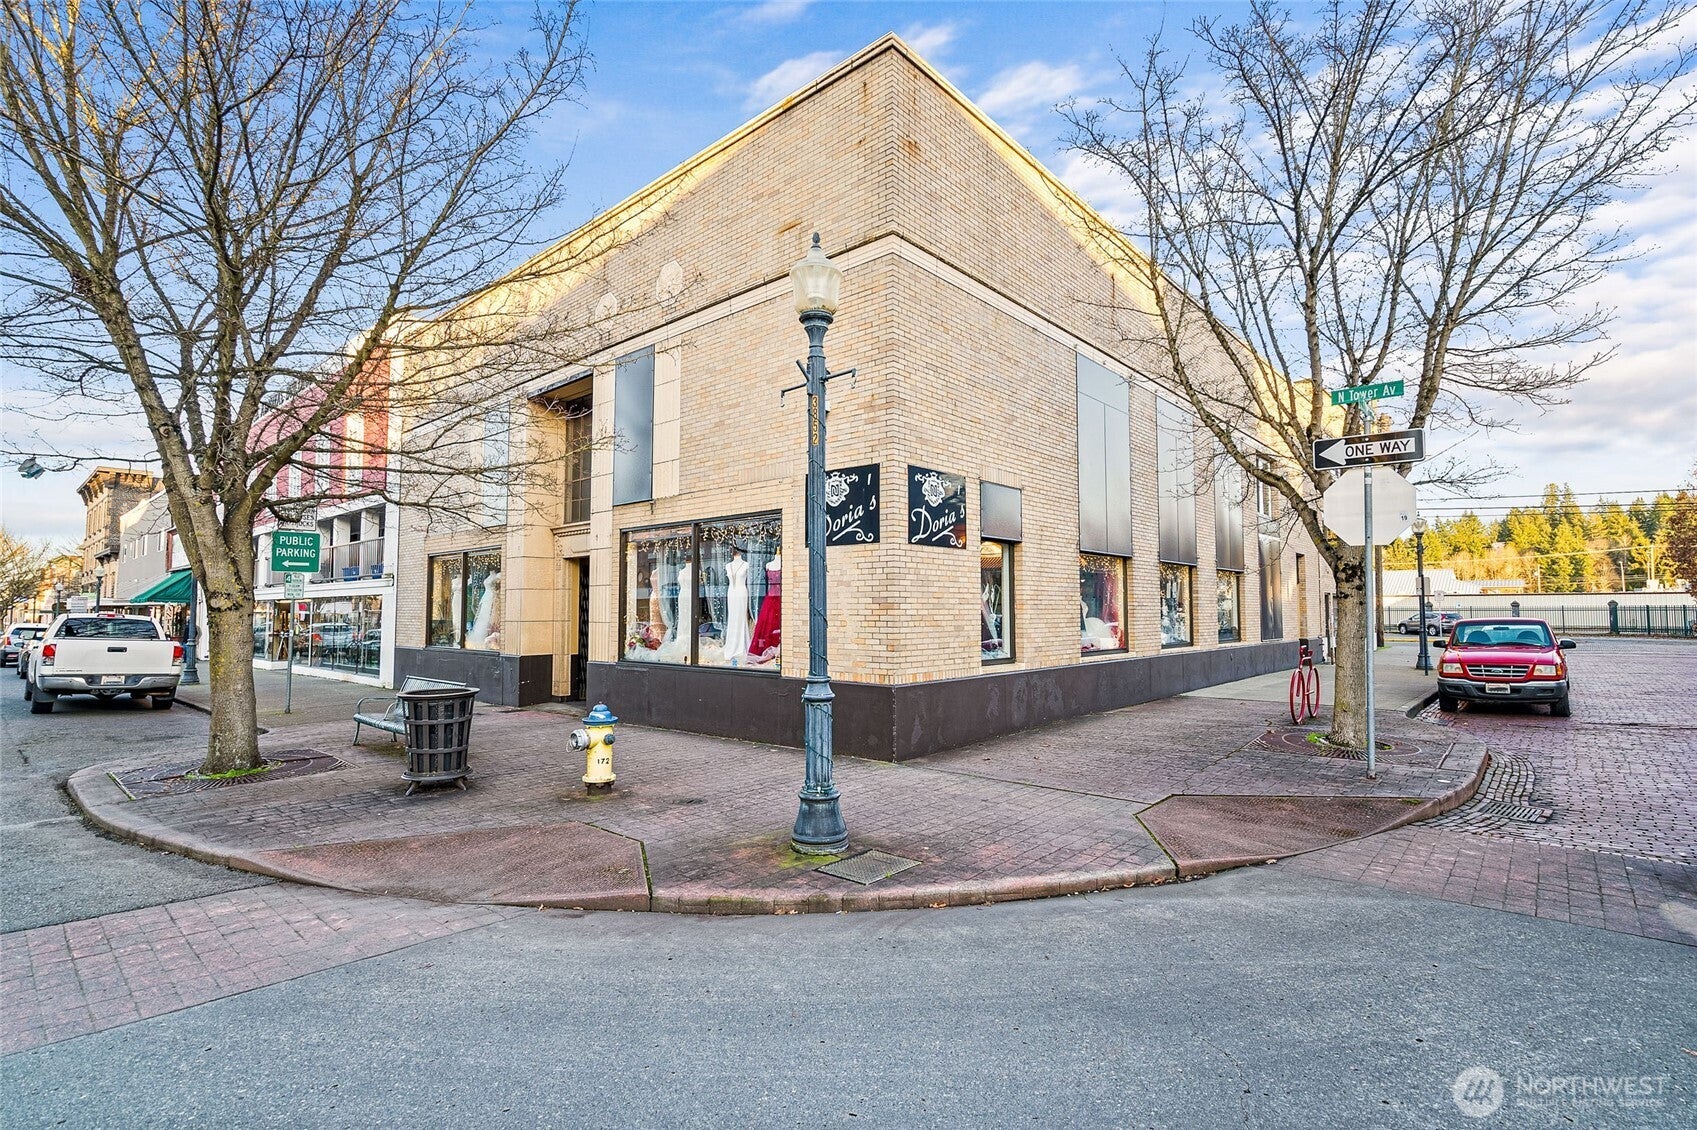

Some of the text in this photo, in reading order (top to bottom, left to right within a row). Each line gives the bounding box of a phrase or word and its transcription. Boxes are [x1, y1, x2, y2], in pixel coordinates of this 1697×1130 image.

[1337, 384, 1397, 403] N Tower Av
[1345, 440, 1411, 458] ONE WAY
[911, 485, 965, 544] Doria's
[279, 536, 314, 546] PUBLIC
[276, 547, 316, 558] PARKING
